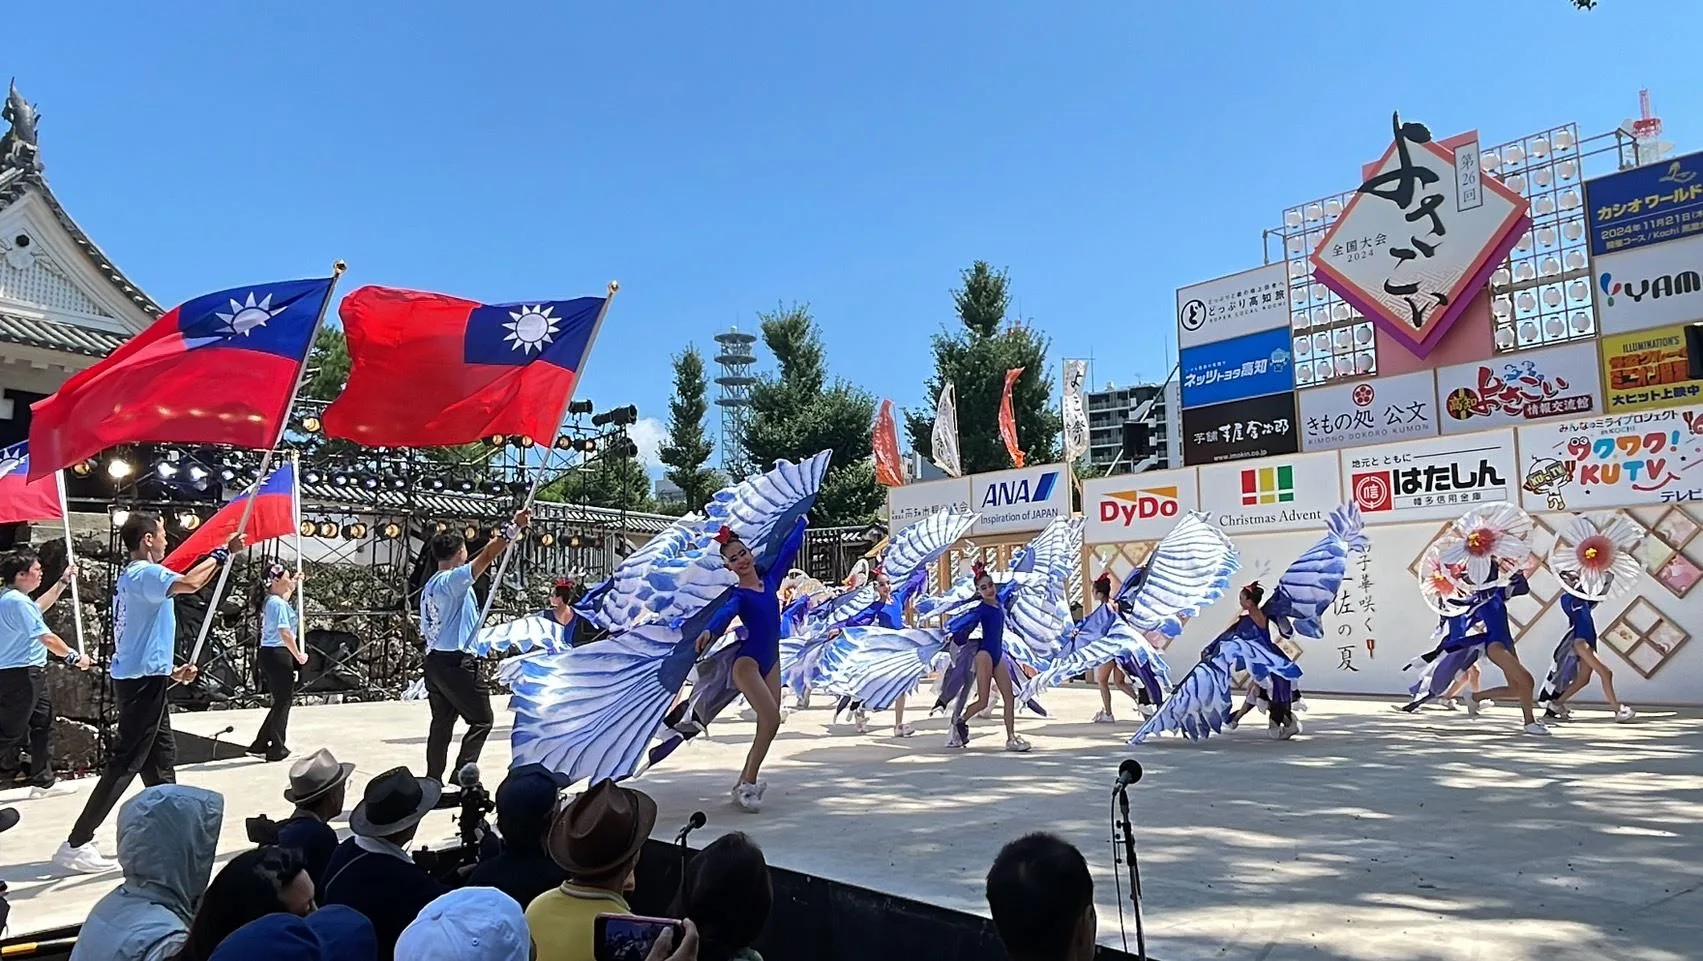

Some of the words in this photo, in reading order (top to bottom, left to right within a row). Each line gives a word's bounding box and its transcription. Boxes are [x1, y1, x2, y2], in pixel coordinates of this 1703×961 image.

[1461, 153, 1477, 203] 第26回
[1332, 232, 1387, 257] 全国大会
[1347, 251, 1374, 263] 2024
[1624, 270, 1703, 302] YAM
[1184, 359, 1268, 388] ネッツトヨタ高知
[1470, 366, 1569, 416] よさこい
[1612, 384, 1700, 406] 大ヒット上映中
[1307, 410, 1374, 435] きもの処
[1384, 401, 1428, 425] 公文
[1527, 398, 1590, 415] 情報交流館
[1308, 435, 1345, 446] KIMONO
[1348, 428, 1388, 440] DOKORO
[1392, 424, 1429, 434] KUMON
[1559, 410, 1678, 433] みんなのミライプロジェクト
[1352, 457, 1379, 468] 地元と
[1384, 453, 1411, 464] ともに
[1580, 458, 1666, 486] KUTV
[1393, 459, 1505, 495] はたしん
[981, 479, 1029, 508] ANA
[981, 513, 1020, 526] Inspiration
[1022, 513, 1031, 521] of
[1032, 508, 1058, 519] JAPAN
[1100, 496, 1178, 526] DyDo
[1219, 513, 1276, 527] Christmas
[1279, 509, 1321, 522] Advent
[1333, 576, 1360, 673] 佐の夏
